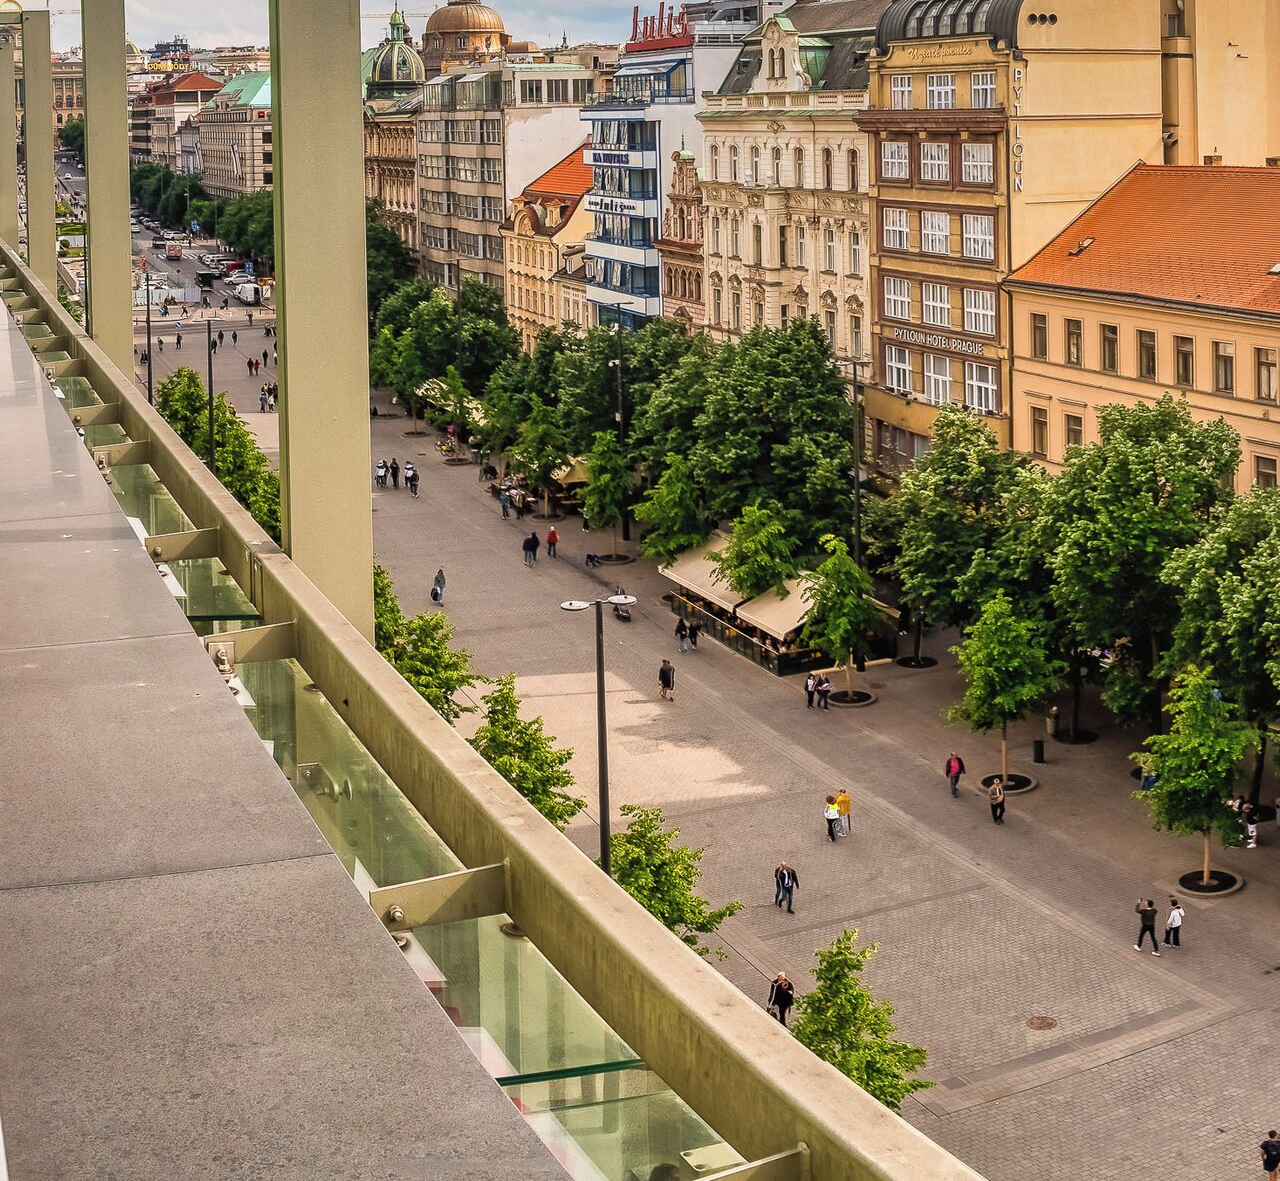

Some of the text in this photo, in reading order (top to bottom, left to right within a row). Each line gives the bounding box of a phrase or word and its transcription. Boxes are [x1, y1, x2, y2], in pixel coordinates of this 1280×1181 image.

[1013, 68, 1024, 192] PYTLOUN
[894, 328, 984, 355] PYTLOUN HOTEL PRAGUE
